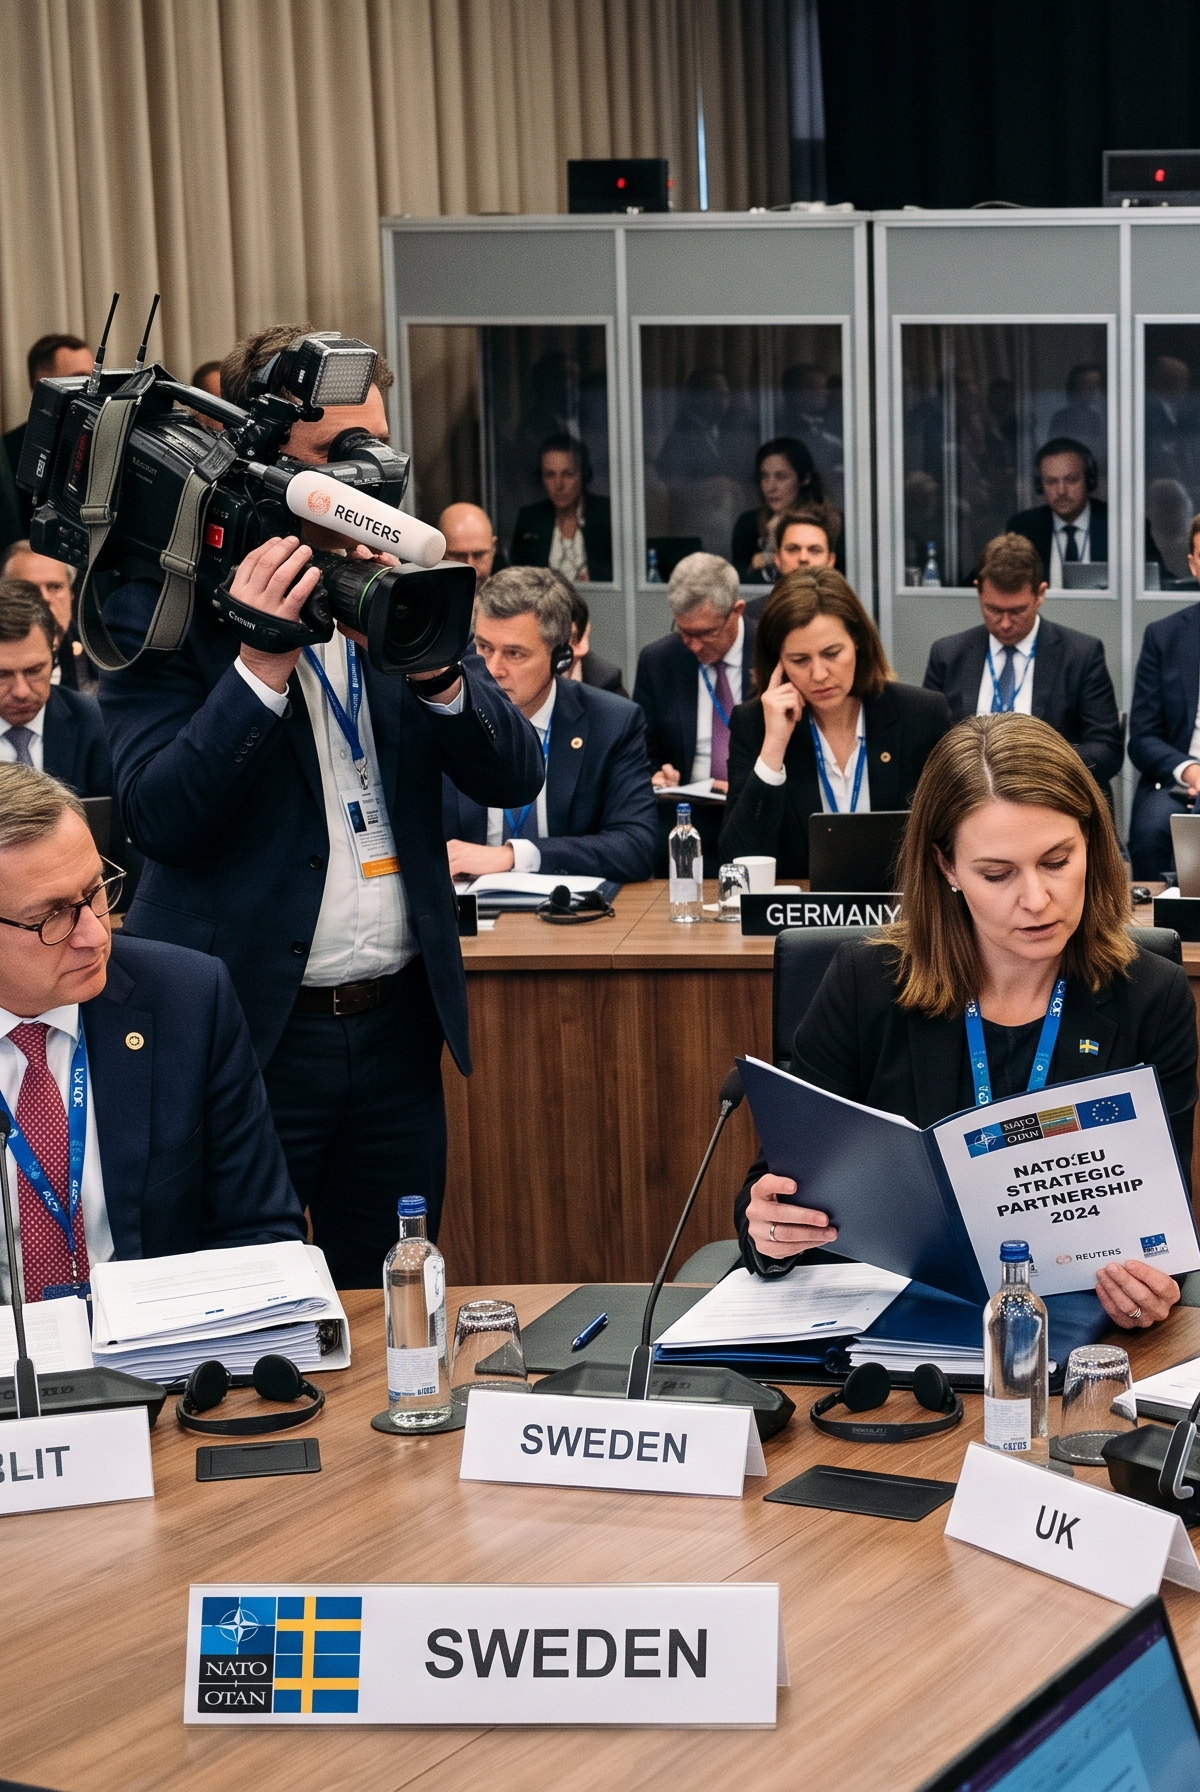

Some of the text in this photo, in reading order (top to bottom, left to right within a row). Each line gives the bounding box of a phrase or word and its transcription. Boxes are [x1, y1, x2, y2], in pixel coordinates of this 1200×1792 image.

[334, 504, 402, 544] REUTERS
[766, 903, 902, 926] GERMANY
[1006, 1164, 1125, 1197] STRATEGIC
[997, 1178, 1143, 1217] PARTNERSHIP
[1050, 1204, 1101, 1224] 2024
[1076, 1248, 1122, 1261] REUTERS
[520, 1423, 688, 1464] SWEDEN
[1035, 1504, 1081, 1551] UK
[205, 1661, 268, 1677] NATO
[424, 1627, 708, 1679] SWEDEN
[204, 1691, 267, 1706] OTAN
